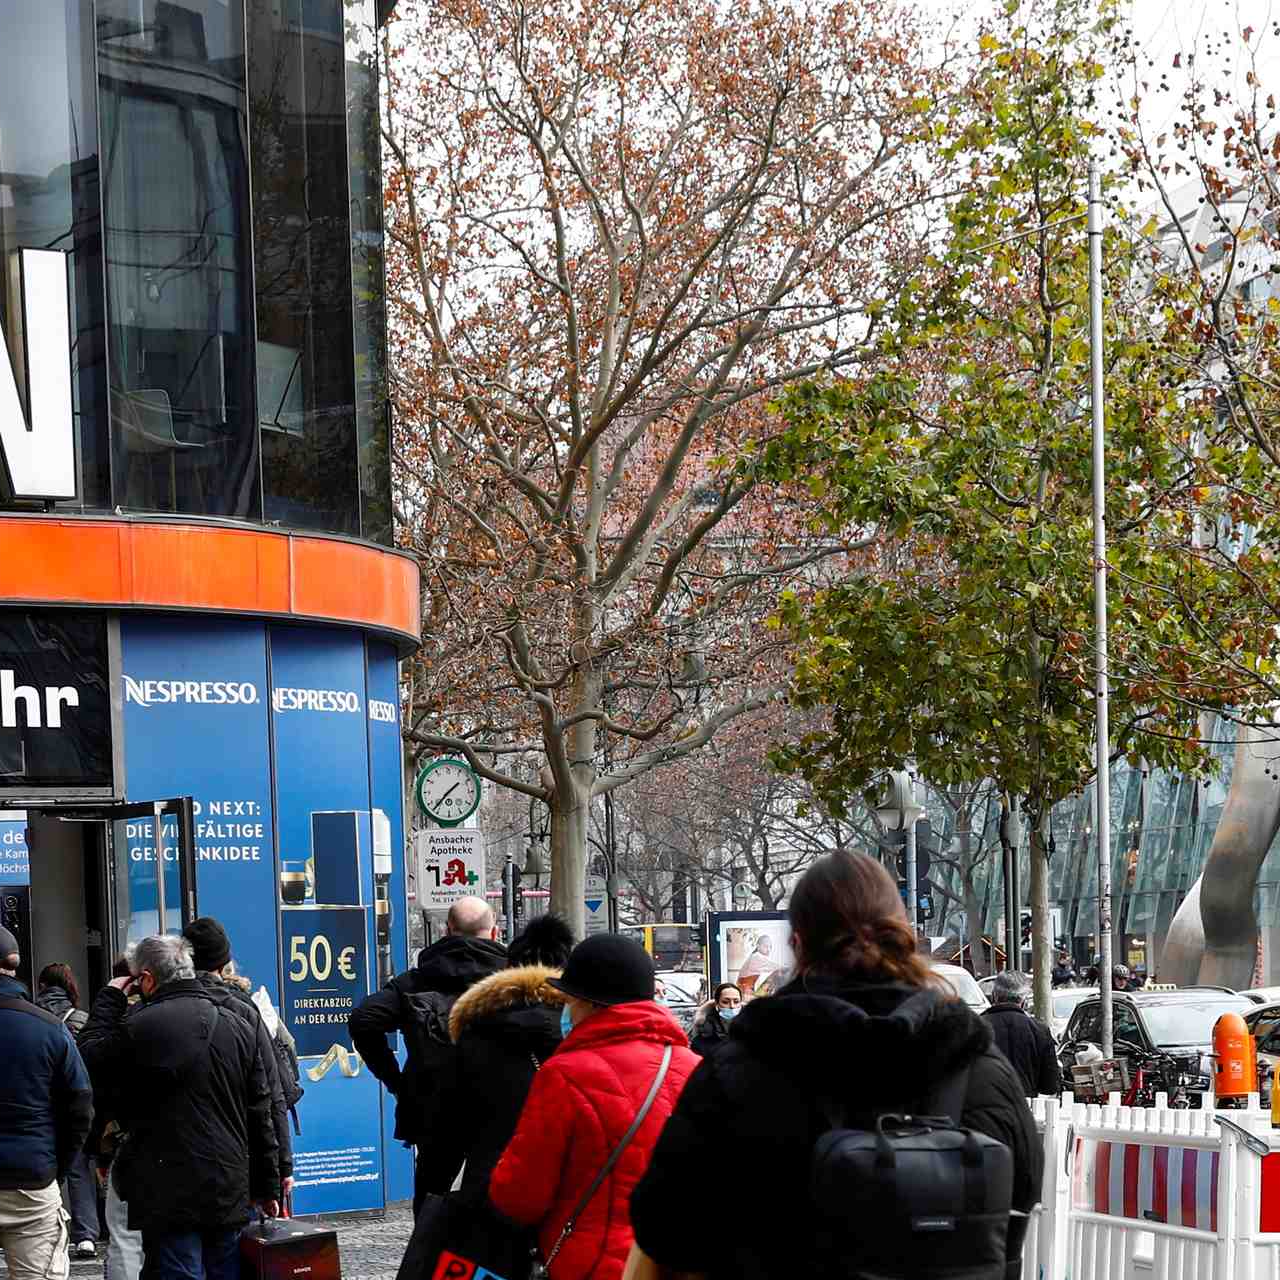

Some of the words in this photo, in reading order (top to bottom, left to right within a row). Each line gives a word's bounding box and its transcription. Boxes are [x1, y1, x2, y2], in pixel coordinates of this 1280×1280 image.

[210, 801, 261, 816] NEXT:
[126, 824, 153, 838] DIE
[428, 834, 475, 845] Ansbacher
[430, 845, 473, 857] Apotheke
[289, 934, 332, 982] 50
[294, 997, 353, 1009] DIREKTABZUG
[294, 1015, 306, 1025] AN
[308, 1014, 326, 1024] DER
[327, 1012, 352, 1024] KASS
